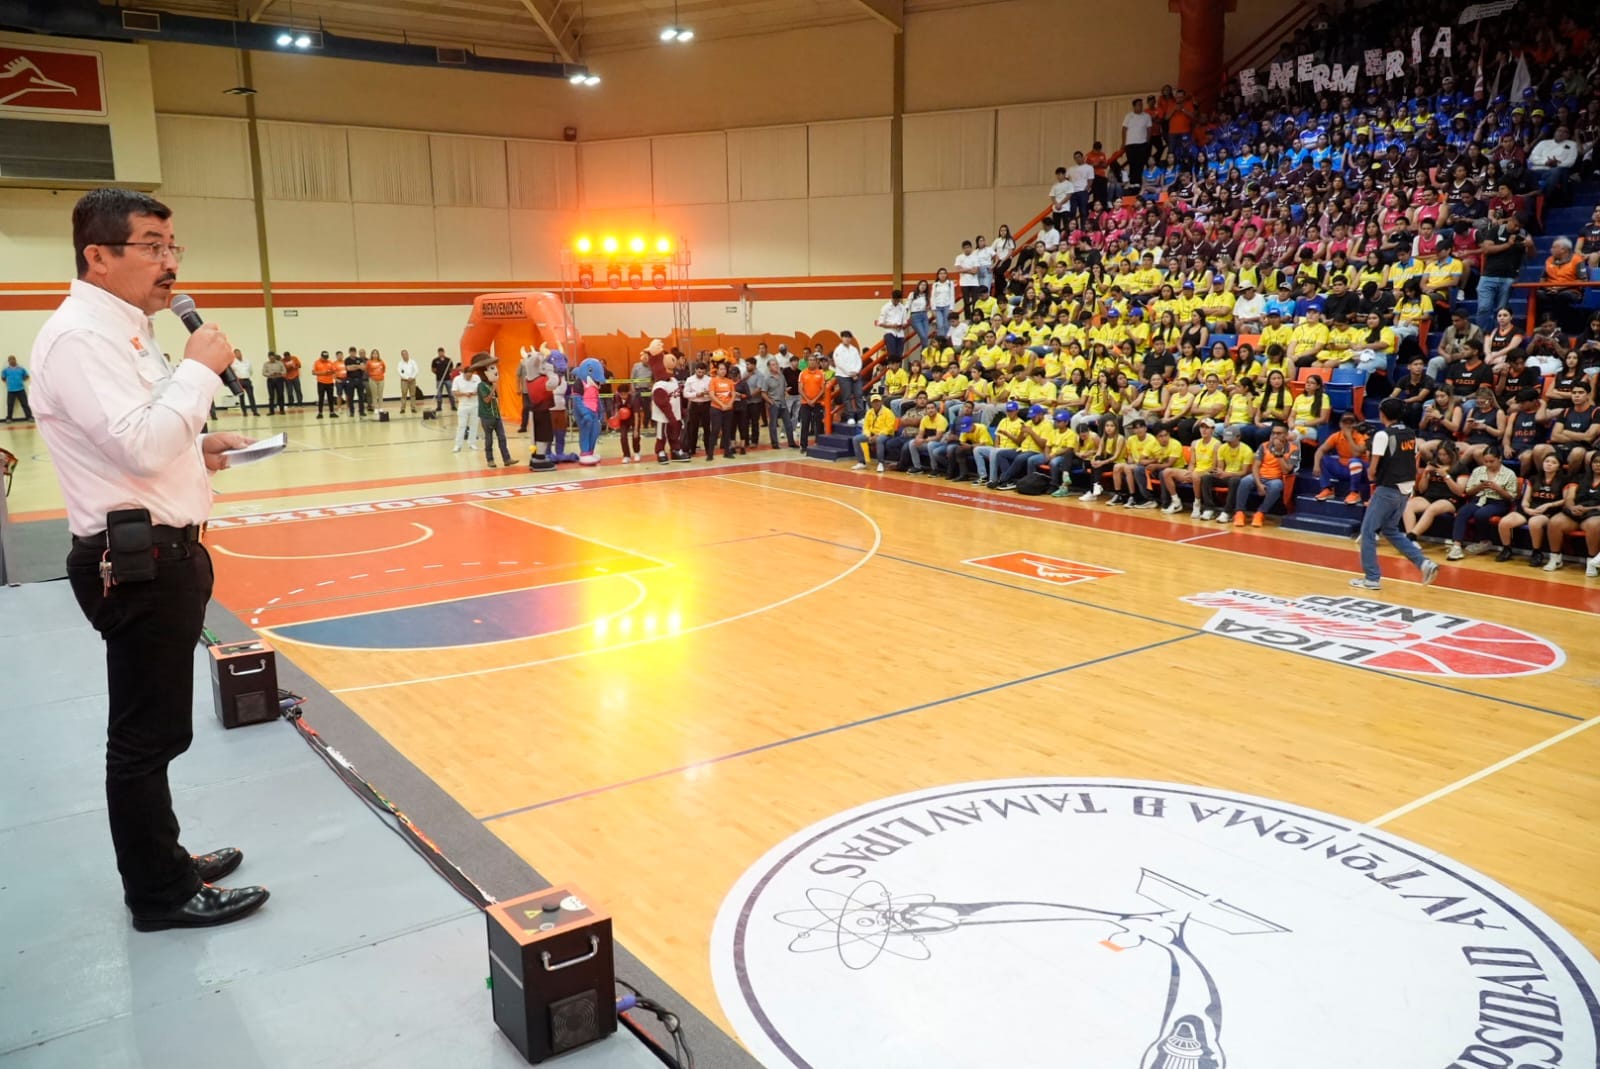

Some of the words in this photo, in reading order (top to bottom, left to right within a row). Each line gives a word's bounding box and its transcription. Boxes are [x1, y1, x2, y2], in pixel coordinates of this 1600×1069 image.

[482, 301, 523, 316] BIENVENIDOS
[1231, 590, 1377, 622] caliente.mx
[1301, 596, 1470, 629] LNBP
[1215, 618, 1377, 662] LIGA
[809, 792, 1108, 879] TAMAVLIPAS
